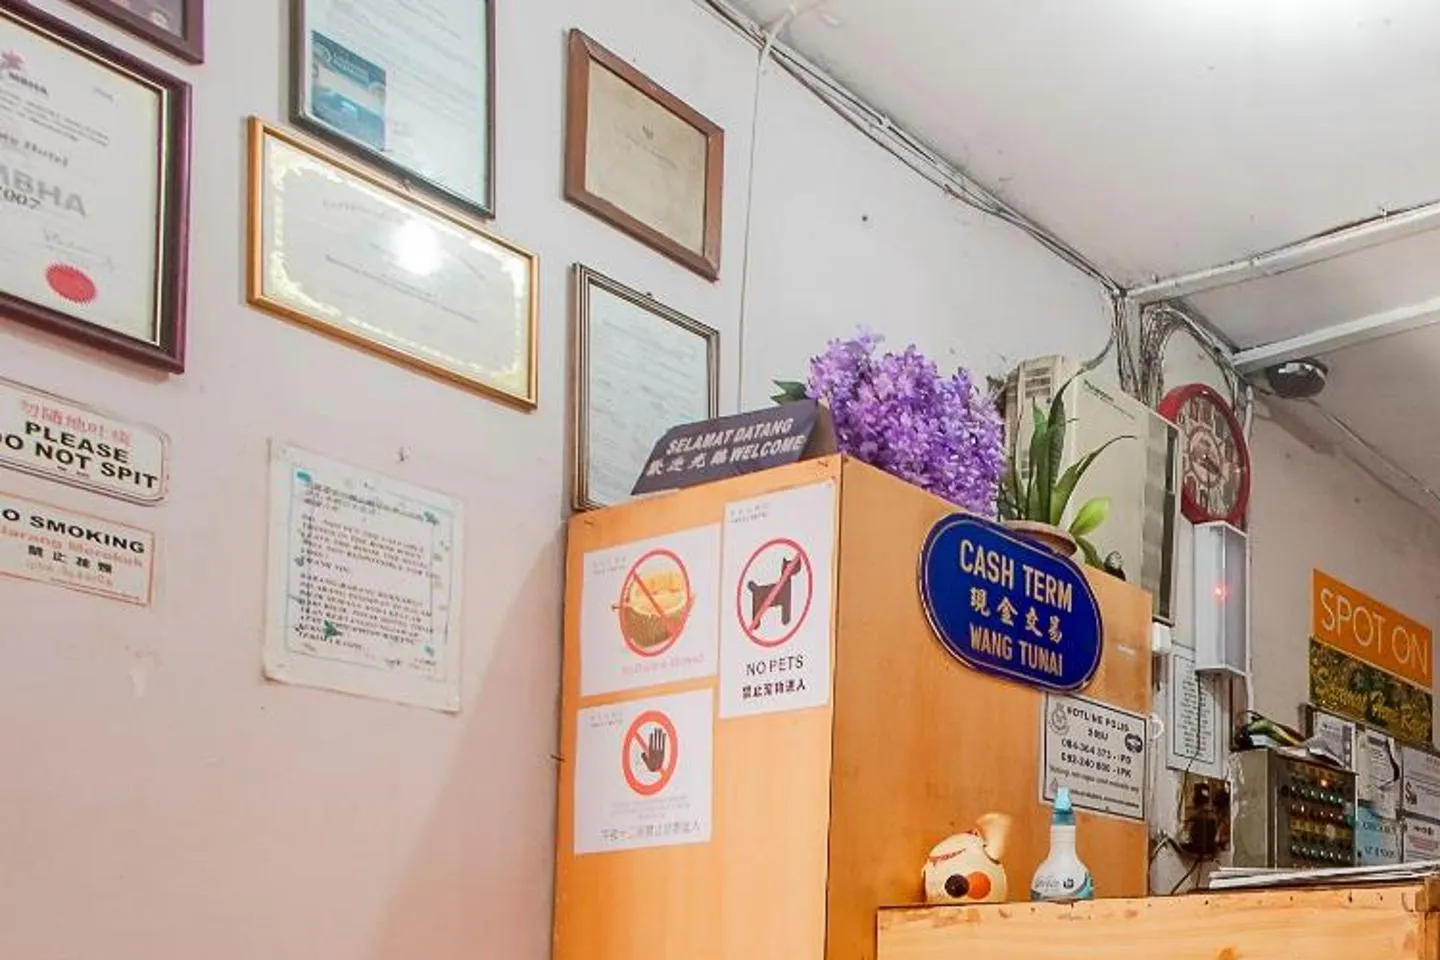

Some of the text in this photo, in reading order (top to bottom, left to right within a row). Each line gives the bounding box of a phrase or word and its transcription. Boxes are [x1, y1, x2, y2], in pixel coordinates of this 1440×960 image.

[0, 186, 41, 210] 007
[25, 421, 129, 464] PLEASE
[666, 417, 794, 455] SELAMAT DATANG
[729, 434, 807, 464] WELCOME
[0, 432, 24, 450] O
[35, 442, 92, 469] NOT
[101, 462, 158, 489] SPIT
[0, 508, 146, 554] O SMOKING
[959, 538, 1073, 614] CASH TERM
[970, 586, 1063, 644] 現金交易
[1319, 587, 1428, 676] SPOT ON
[746, 654, 805, 677] NO PETS
[969, 621, 1063, 677] WANG TUNAI
[1066, 706, 1103, 725] HOTLINE
